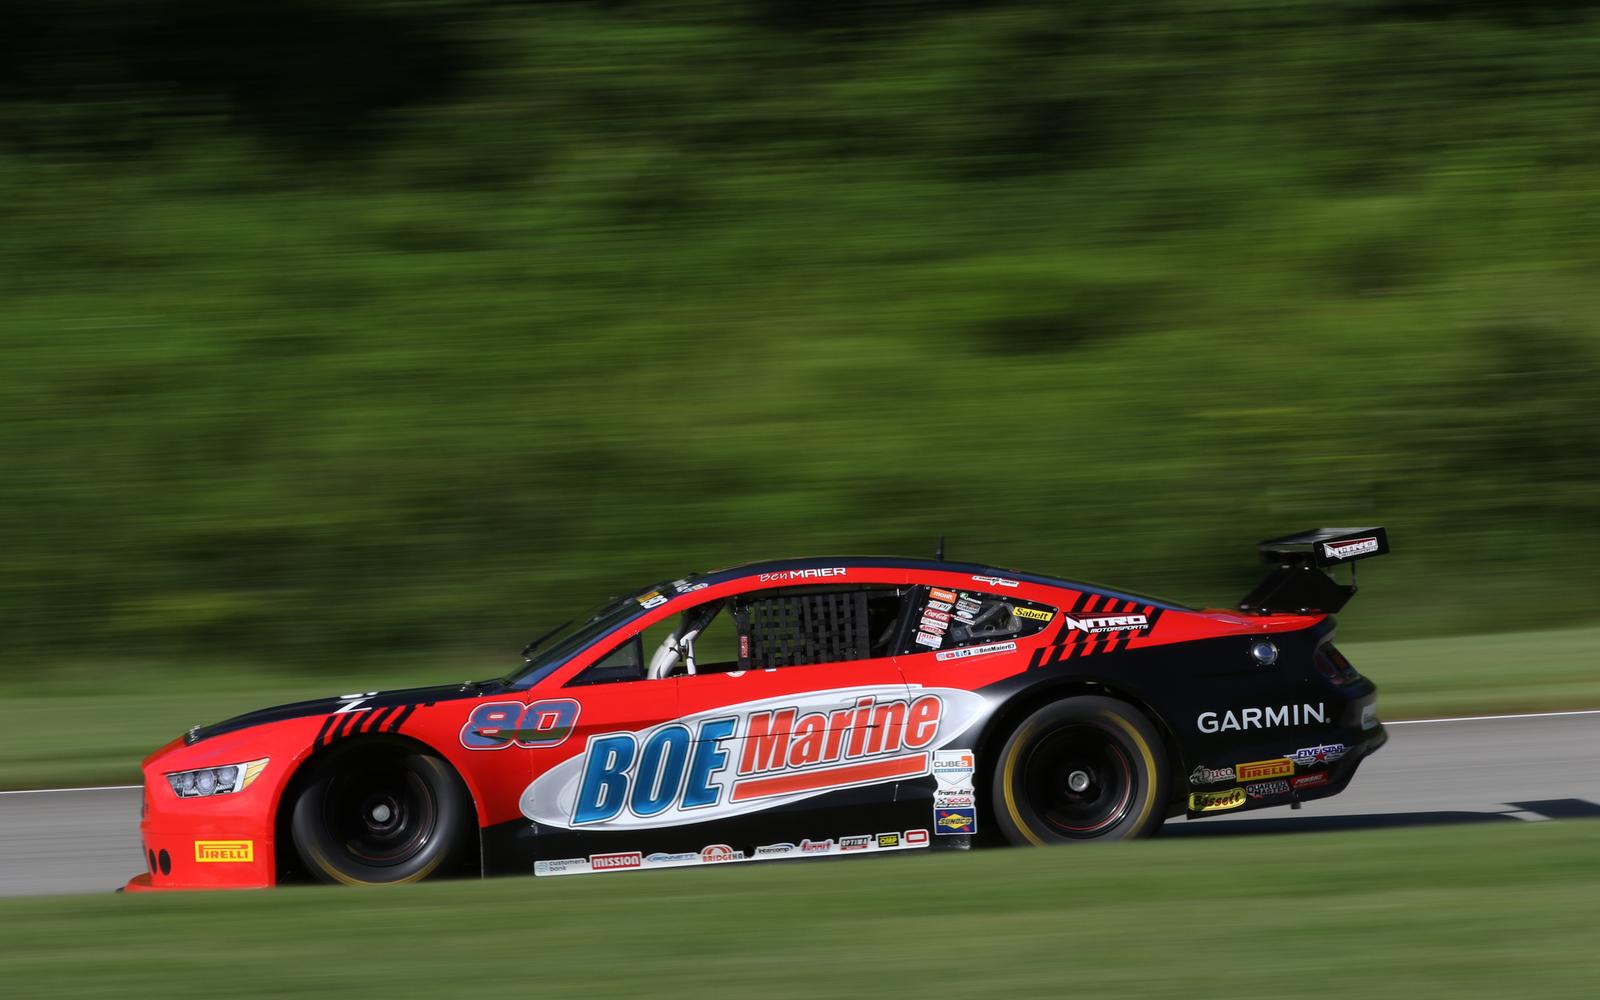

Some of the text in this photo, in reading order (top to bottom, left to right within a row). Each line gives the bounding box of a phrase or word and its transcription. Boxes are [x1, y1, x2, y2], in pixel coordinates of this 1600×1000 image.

[759, 568, 847, 582] Ben MAIER
[1015, 608, 1049, 620] Sabelt
[1065, 614, 1148, 633] NITRO
[1090, 624, 1149, 634] MOTORSPORTS
[1197, 703, 1324, 734] GARMIN
[1298, 748, 1320, 758] FIVE
[1322, 745, 1344, 754] STAR
[571, 695, 943, 827] BOE Marine
[1239, 760, 1292, 779] PIRELLI
[938, 817, 972, 825] SUNOCO
[841, 838, 869, 847] OPTIMA
[880, 837, 897, 846] OMP
[199, 844, 248, 858] PIRELLI
